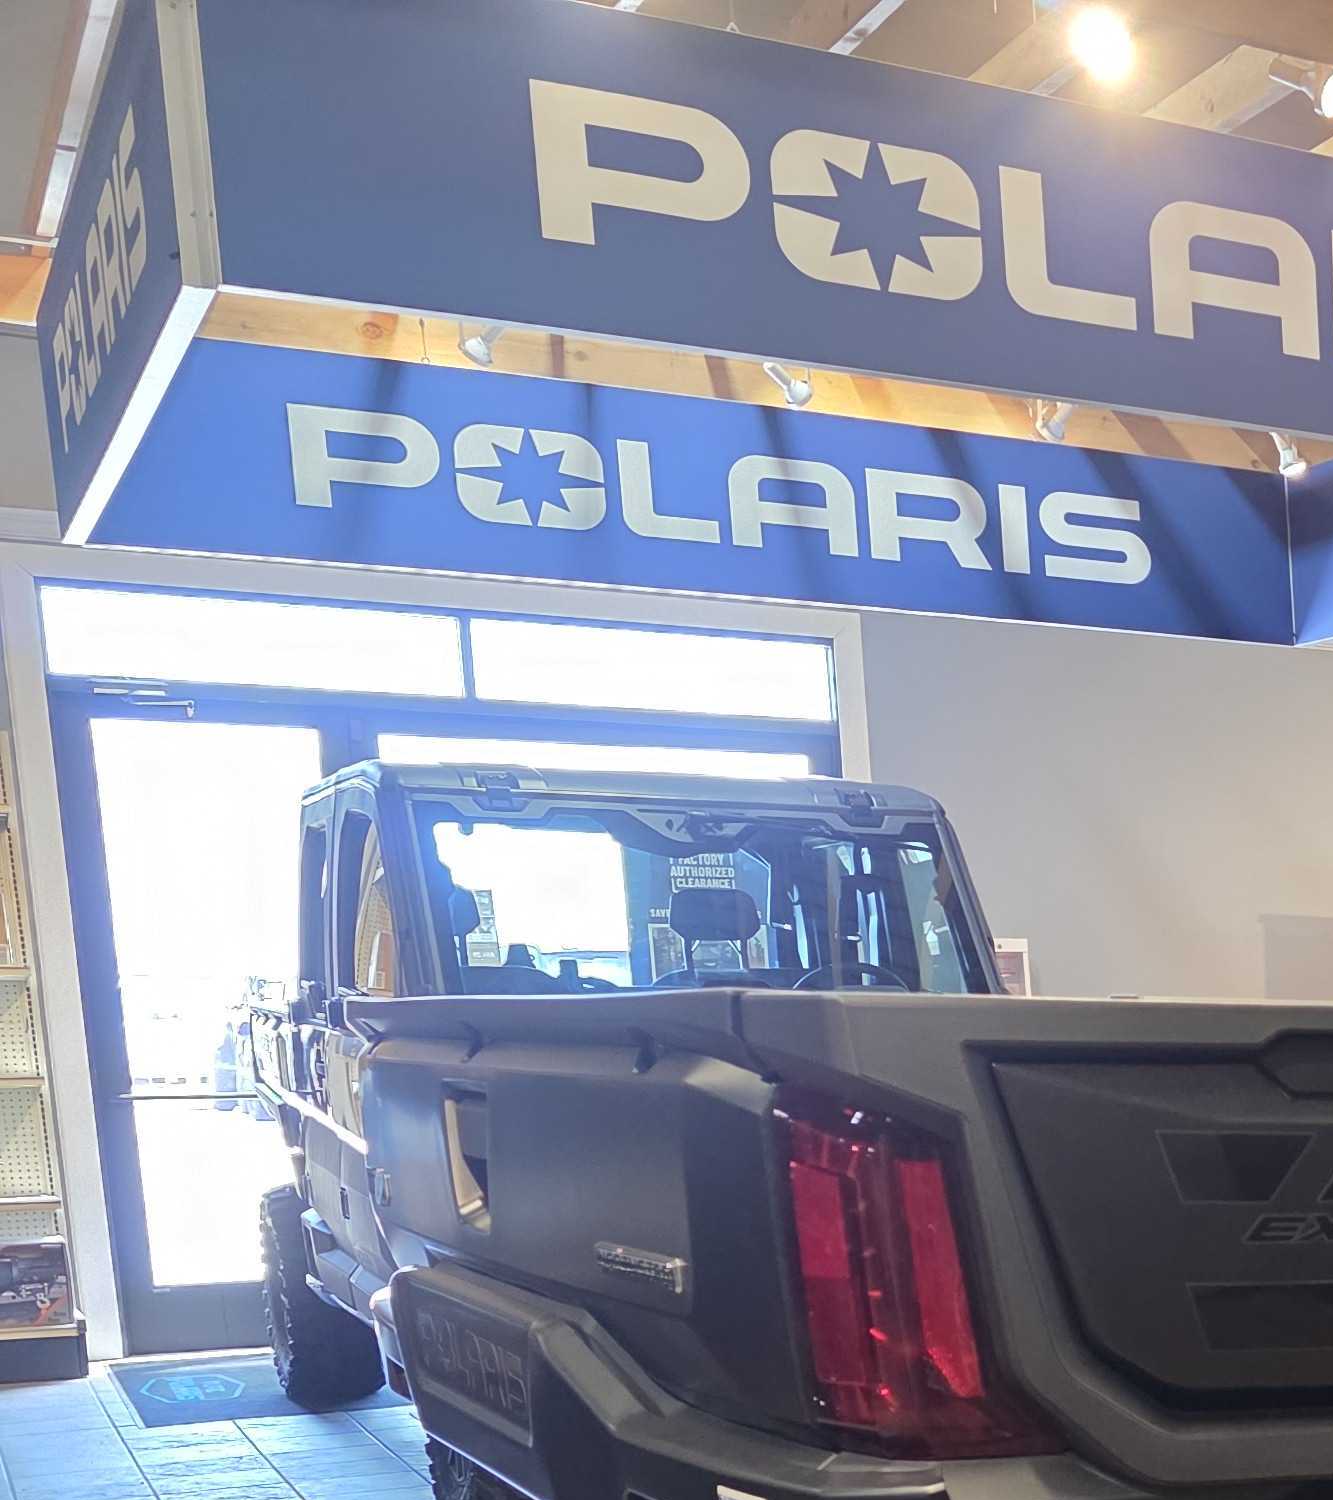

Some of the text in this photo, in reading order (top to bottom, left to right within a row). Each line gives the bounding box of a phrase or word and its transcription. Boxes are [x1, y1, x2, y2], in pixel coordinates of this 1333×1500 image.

[52, 103, 147, 453] POLARIS
[286, 402, 1152, 585] POLARIS
[678, 853, 724, 865] FACTORY
[670, 866, 735, 878] AUTHORIZED
[676, 878, 731, 889] CLEARANCE
